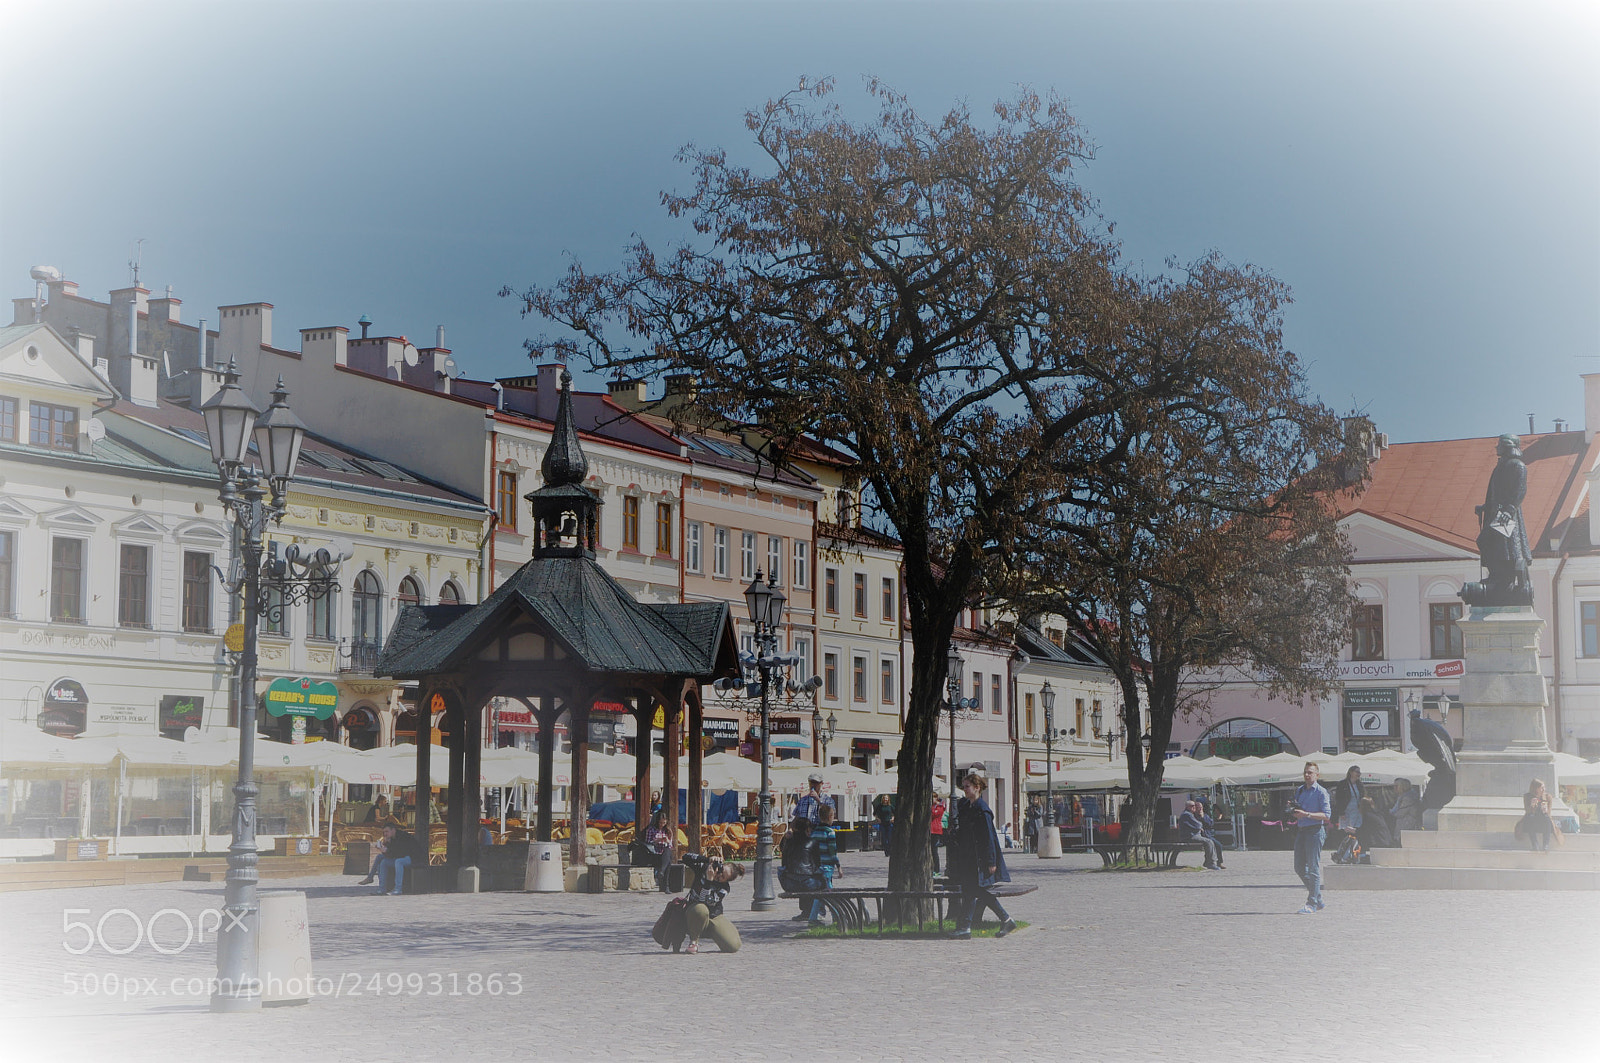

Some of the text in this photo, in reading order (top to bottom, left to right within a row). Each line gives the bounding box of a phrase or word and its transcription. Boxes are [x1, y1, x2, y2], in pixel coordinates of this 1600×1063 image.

[1353, 664, 1394, 677] obcych
[1406, 669, 1432, 677] empik
[1438, 664, 1461, 674] school
[309, 694, 337, 706] HOUSE
[702, 720, 738, 730] MANHATTAN
[780, 721, 797, 729] rdza
